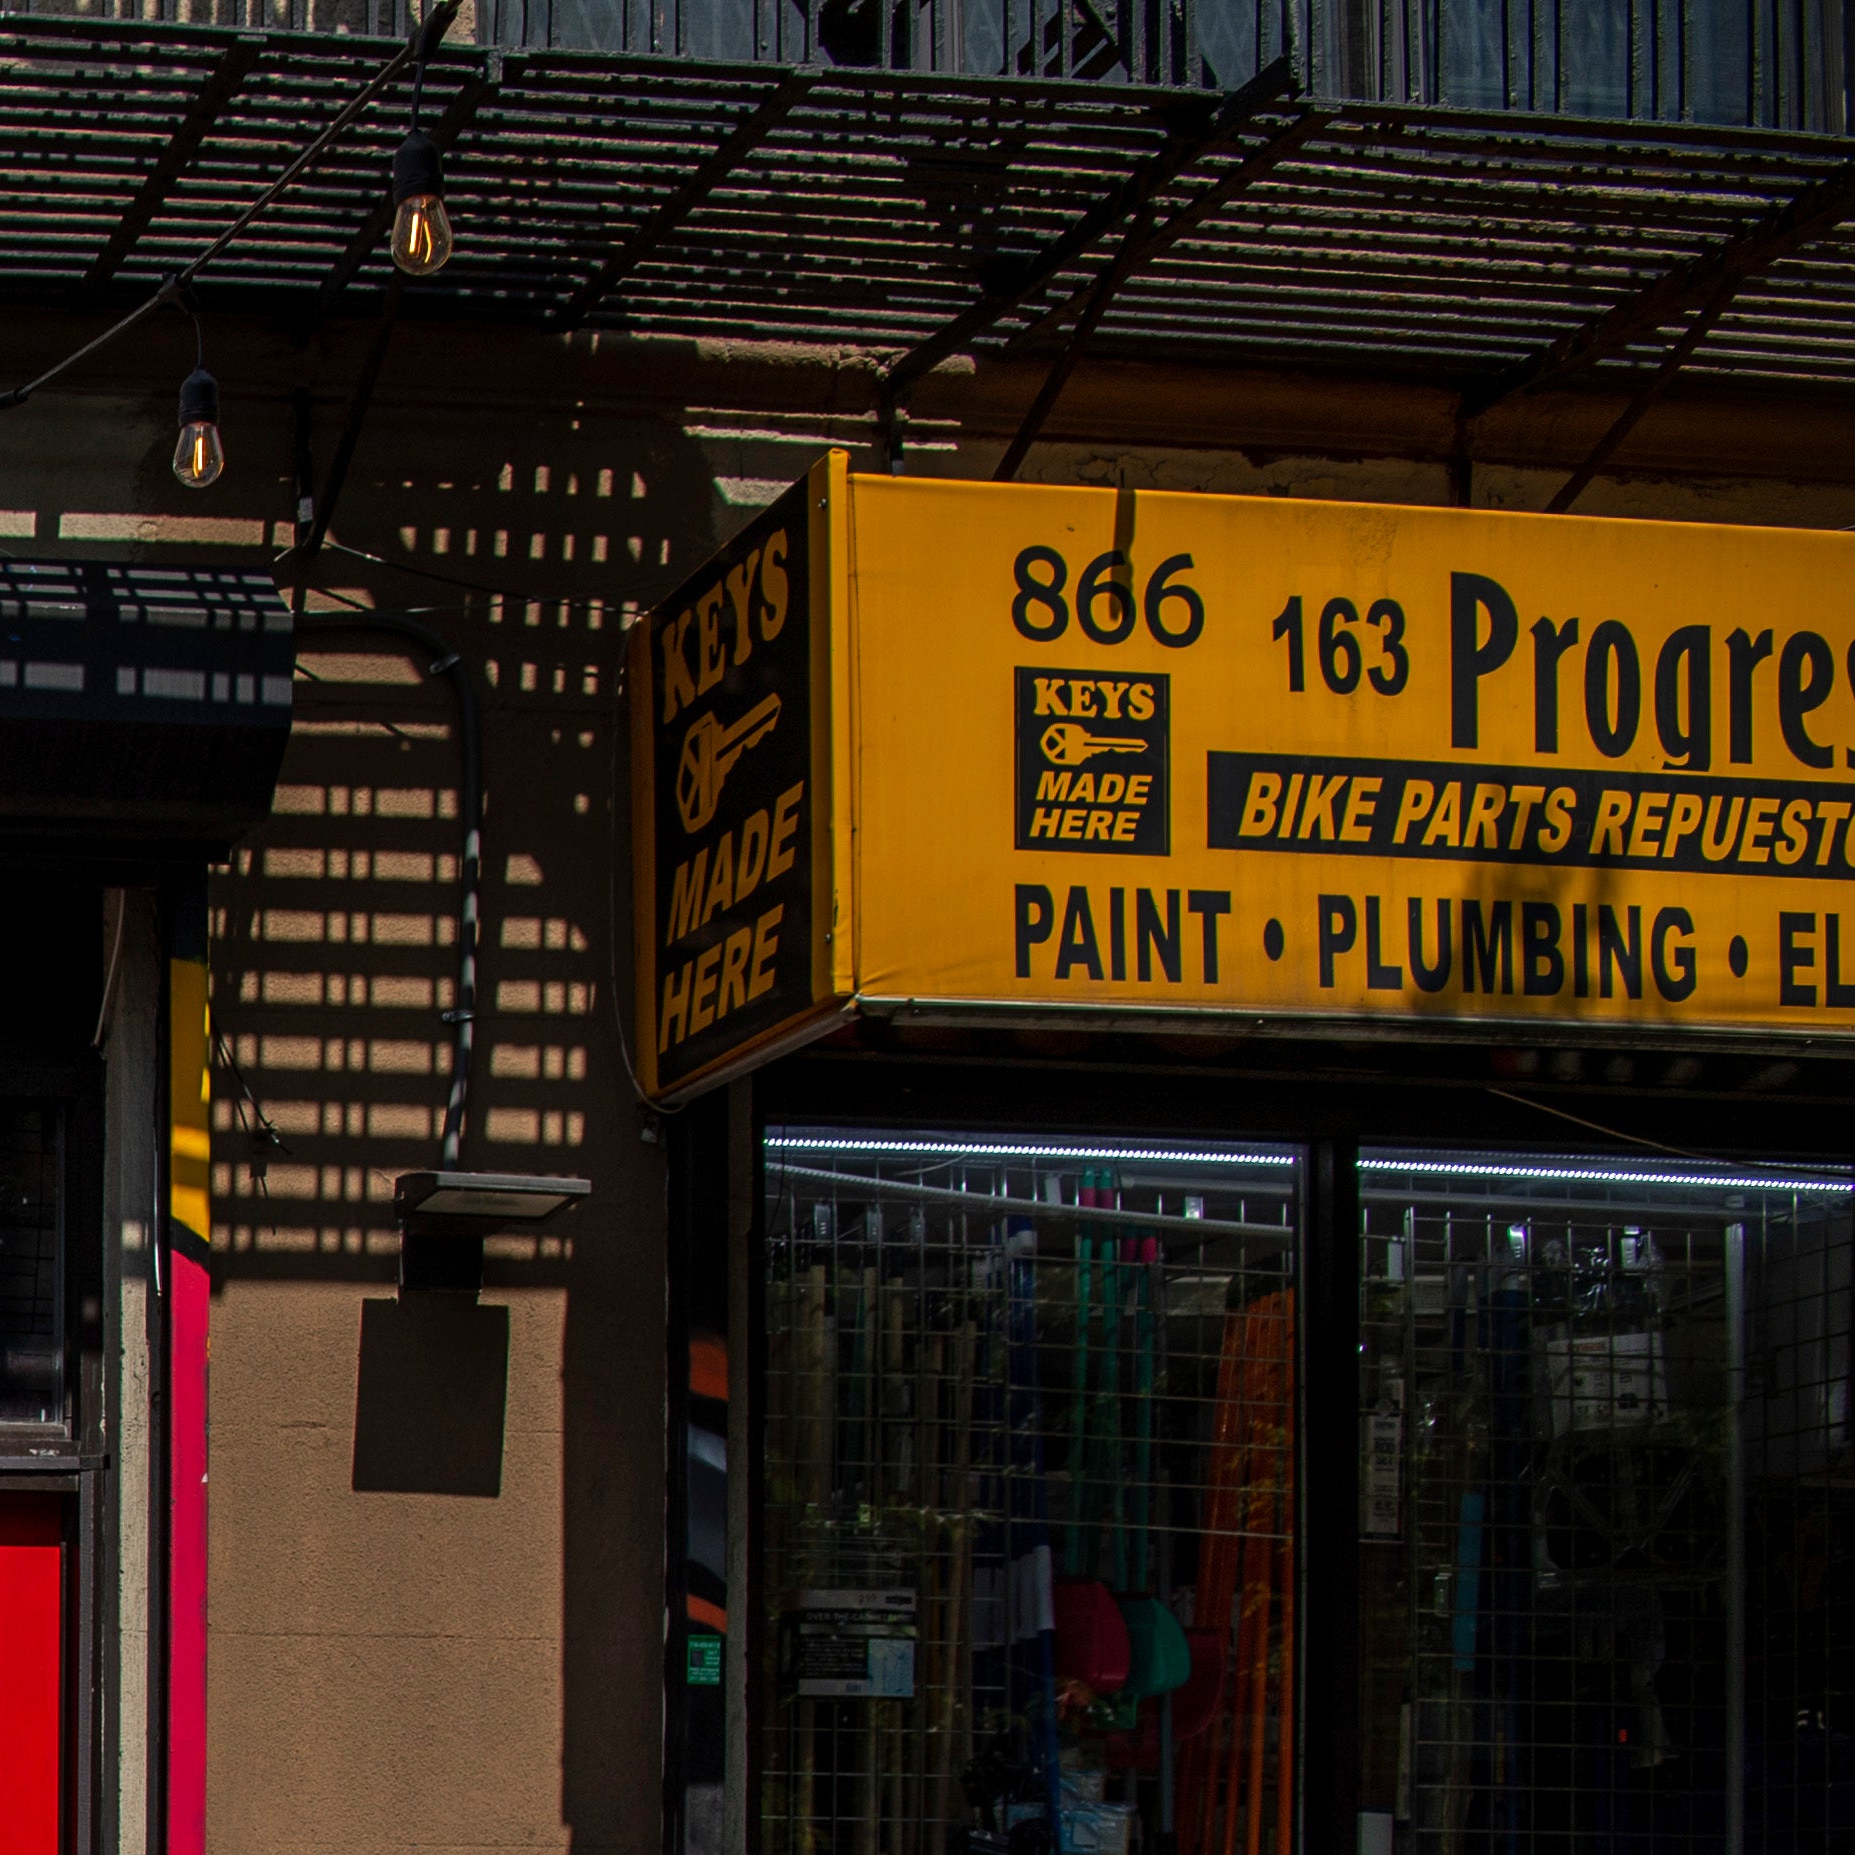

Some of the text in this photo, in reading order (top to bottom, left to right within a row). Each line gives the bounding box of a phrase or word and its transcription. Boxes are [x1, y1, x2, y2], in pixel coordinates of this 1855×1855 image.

[662, 528, 788, 725] KEYS
[1012, 545, 1204, 648] 866
[1033, 678, 1155, 720] KEYS
[1272, 571, 1855, 772] 163 Progre
[1029, 807, 1141, 841] HERE
[1036, 771, 1153, 805] MADE
[1237, 773, 1855, 867] BIKE PARTS REPUEST
[666, 780, 804, 946] MADE
[658, 902, 784, 1054] HERE
[1014, 884, 1855, 1008] PAINT PLUMBING EL
